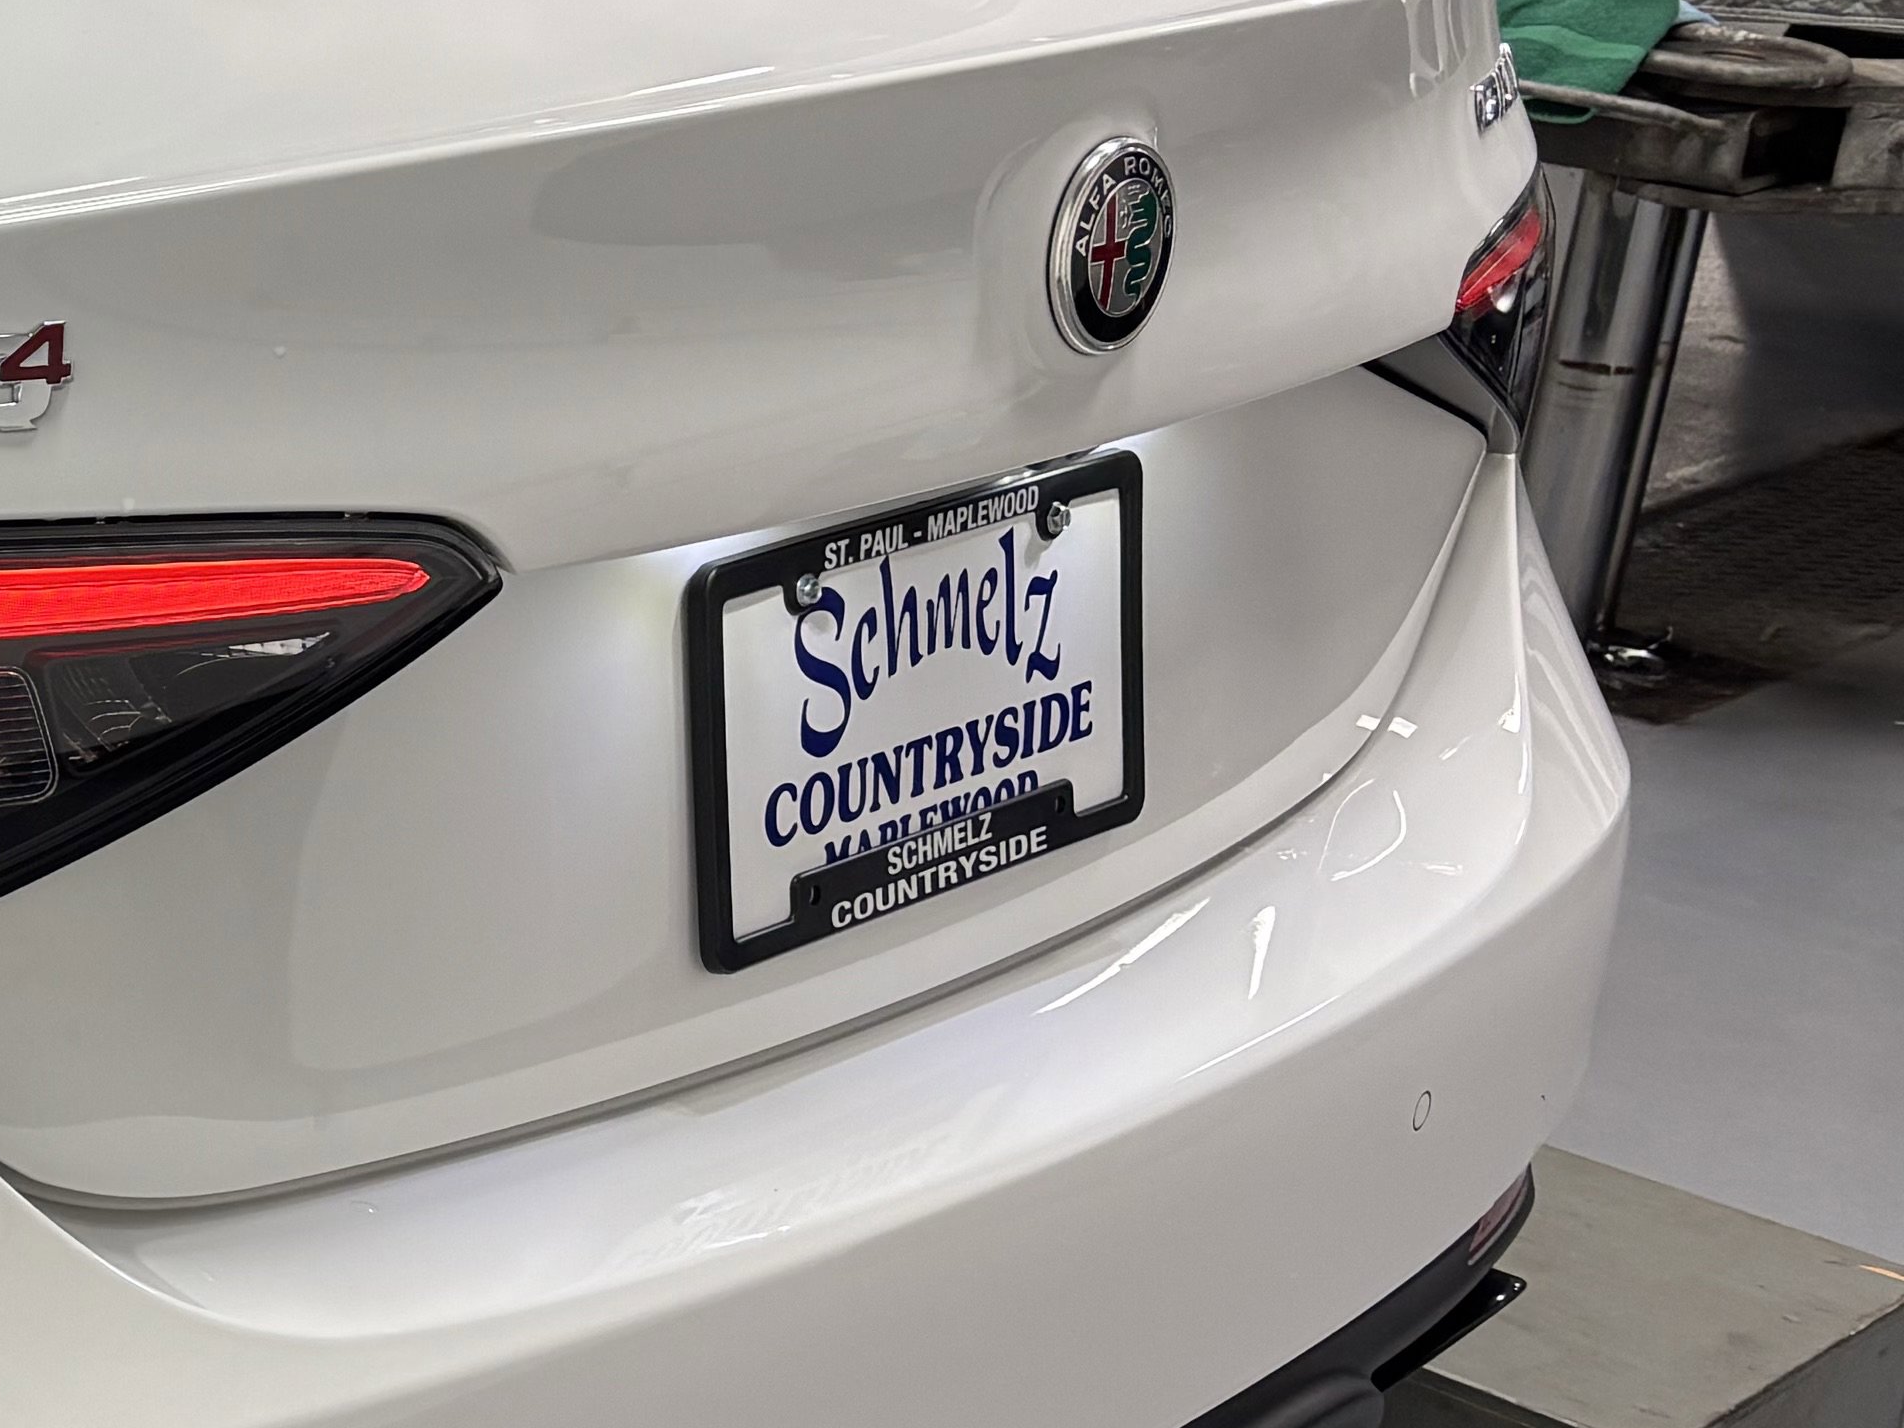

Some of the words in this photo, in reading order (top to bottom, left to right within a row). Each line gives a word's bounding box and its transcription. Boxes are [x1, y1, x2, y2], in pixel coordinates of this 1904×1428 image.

[1075, 173, 1117, 257] ALFA
[1124, 155, 1172, 238] ROMEO
[824, 538, 854, 570] ST.
[860, 523, 909, 560] PAUL
[927, 485, 1039, 542] MAPLEWOOD
[794, 526, 1062, 758] Schmelz
[764, 680, 1093, 848] COUNTRYSIDE
[831, 825, 1048, 929] COUNTRYSIDE
[887, 811, 993, 876] SCHMELZ
